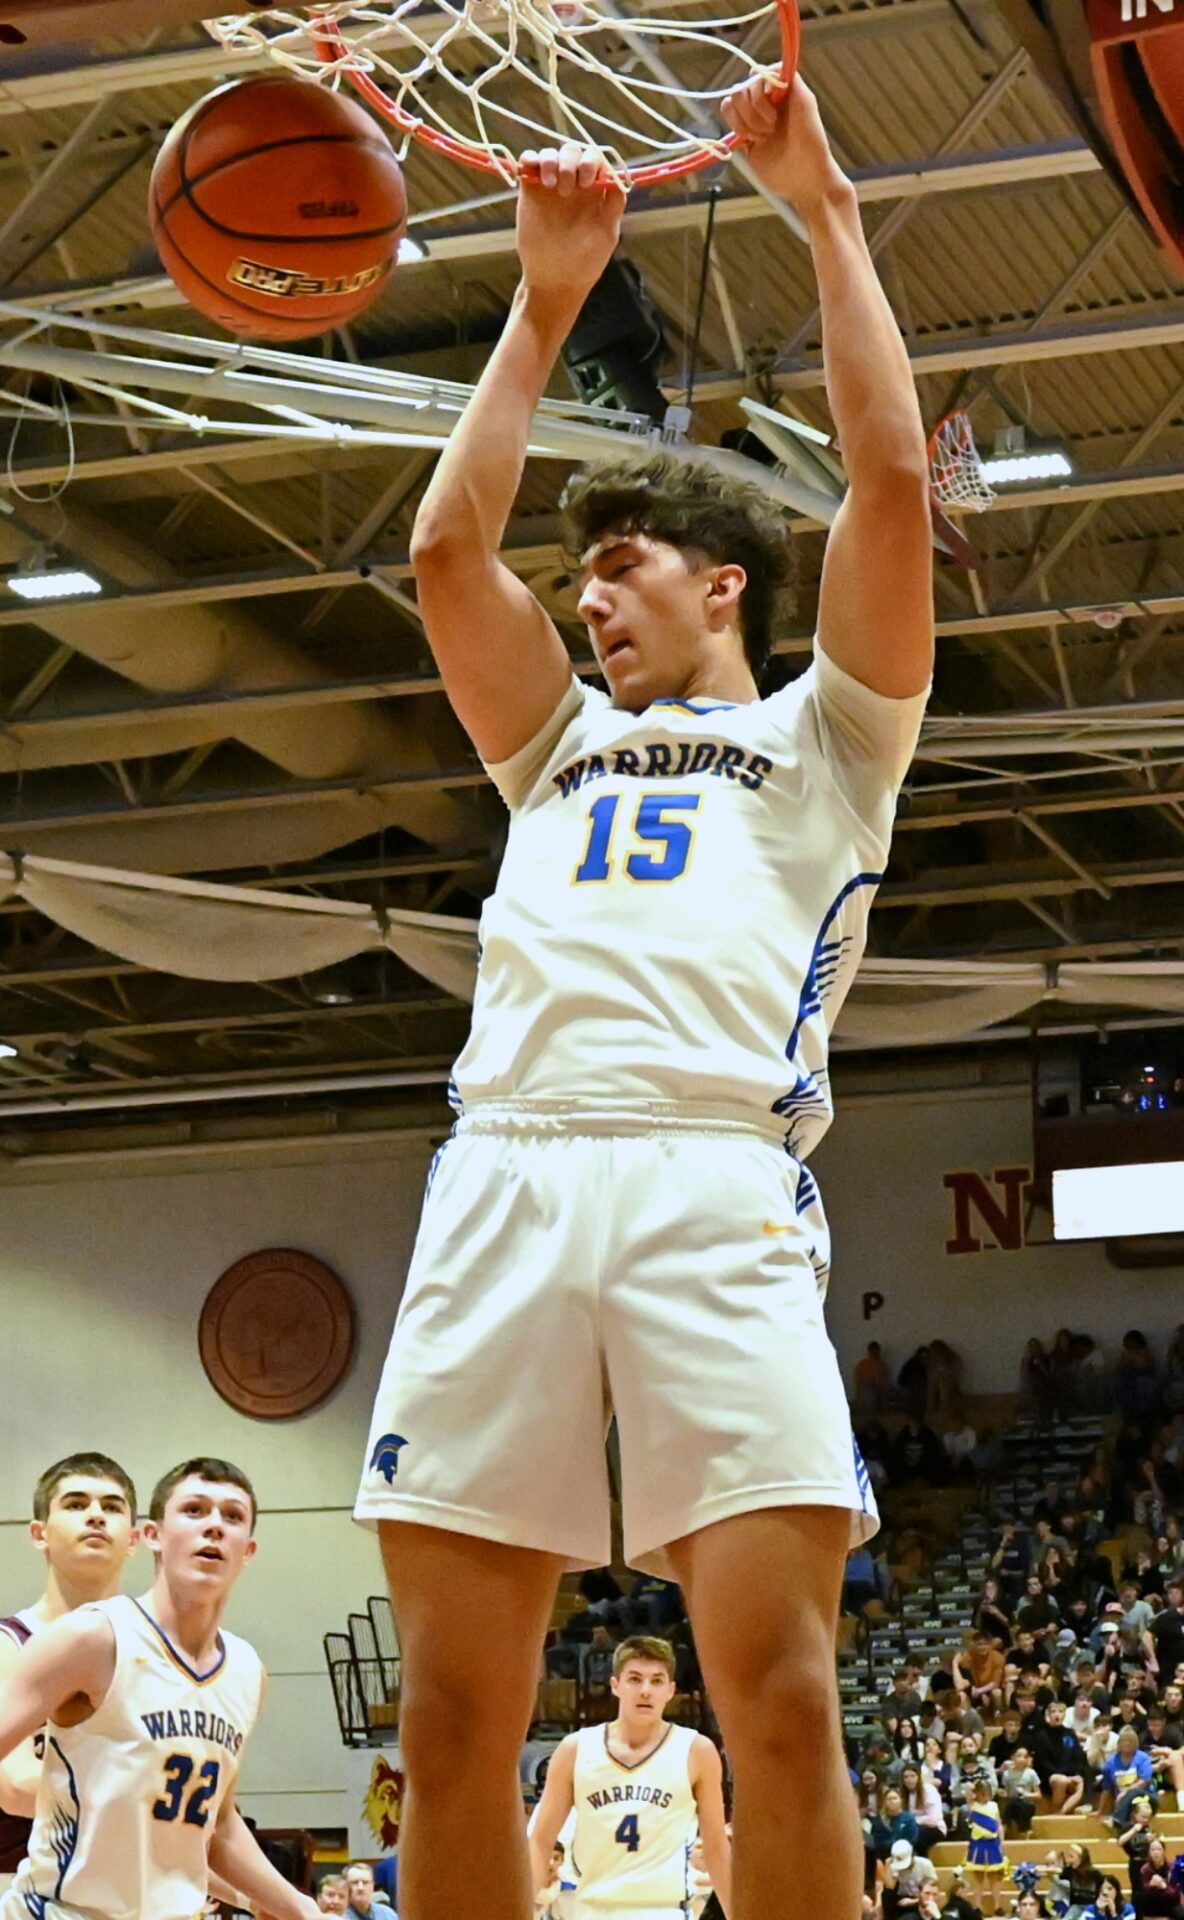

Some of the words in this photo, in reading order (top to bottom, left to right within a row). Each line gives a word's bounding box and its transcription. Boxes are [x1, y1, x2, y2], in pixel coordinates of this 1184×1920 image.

[552, 742, 774, 800] WARRIORS
[570, 790, 705, 887] 15
[942, 1166, 1033, 1255] N
[863, 1291, 884, 1320] P
[843, 1715, 864, 1724] NVC
[860, 1696, 880, 1704] NVC
[140, 1708, 243, 1758] WARRIORS
[152, 1753, 221, 1828] 32
[586, 1785, 673, 1810] WARRIORS
[615, 1814, 640, 1852] 4
